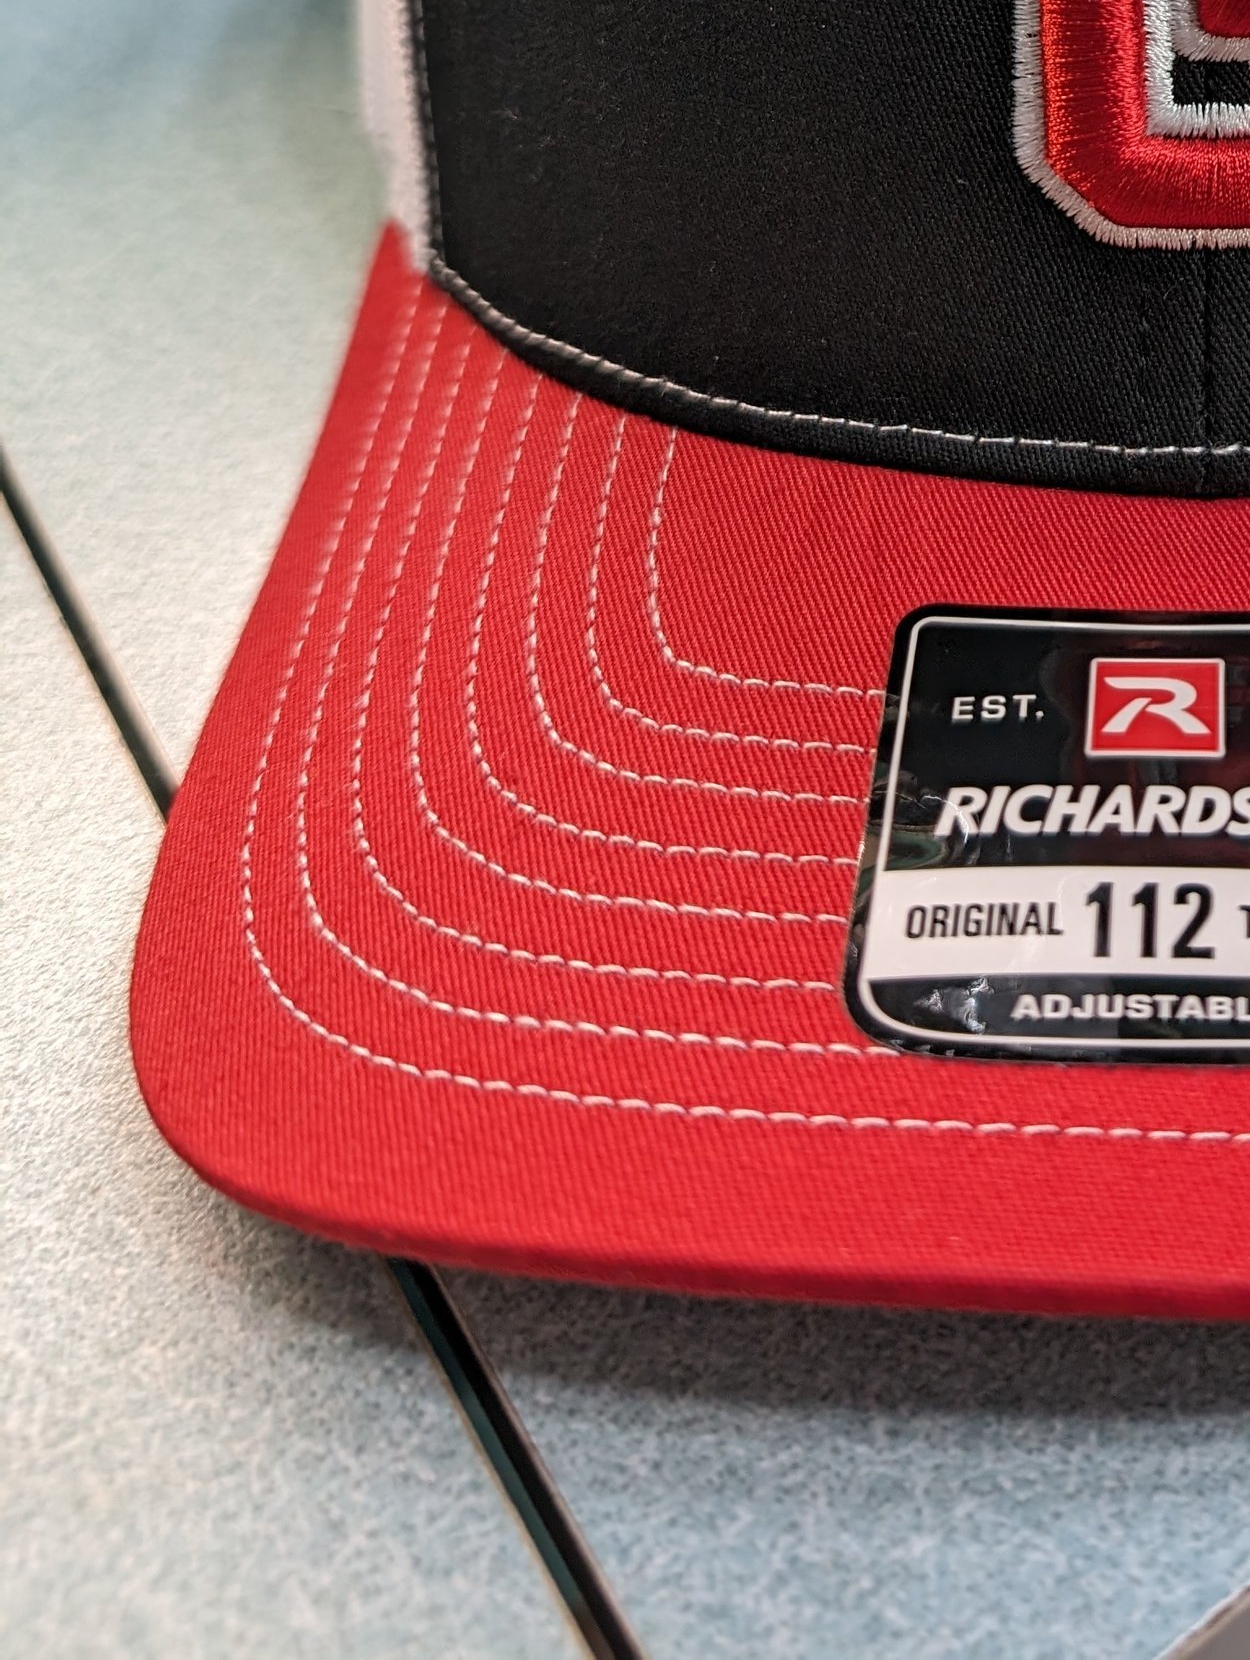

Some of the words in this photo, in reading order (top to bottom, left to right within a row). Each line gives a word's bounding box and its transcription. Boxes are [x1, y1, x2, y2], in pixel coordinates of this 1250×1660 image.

[950, 693, 1045, 723] EST.
[905, 900, 1064, 940] ORIGINAL
[1083, 881, 1217, 960] 112
